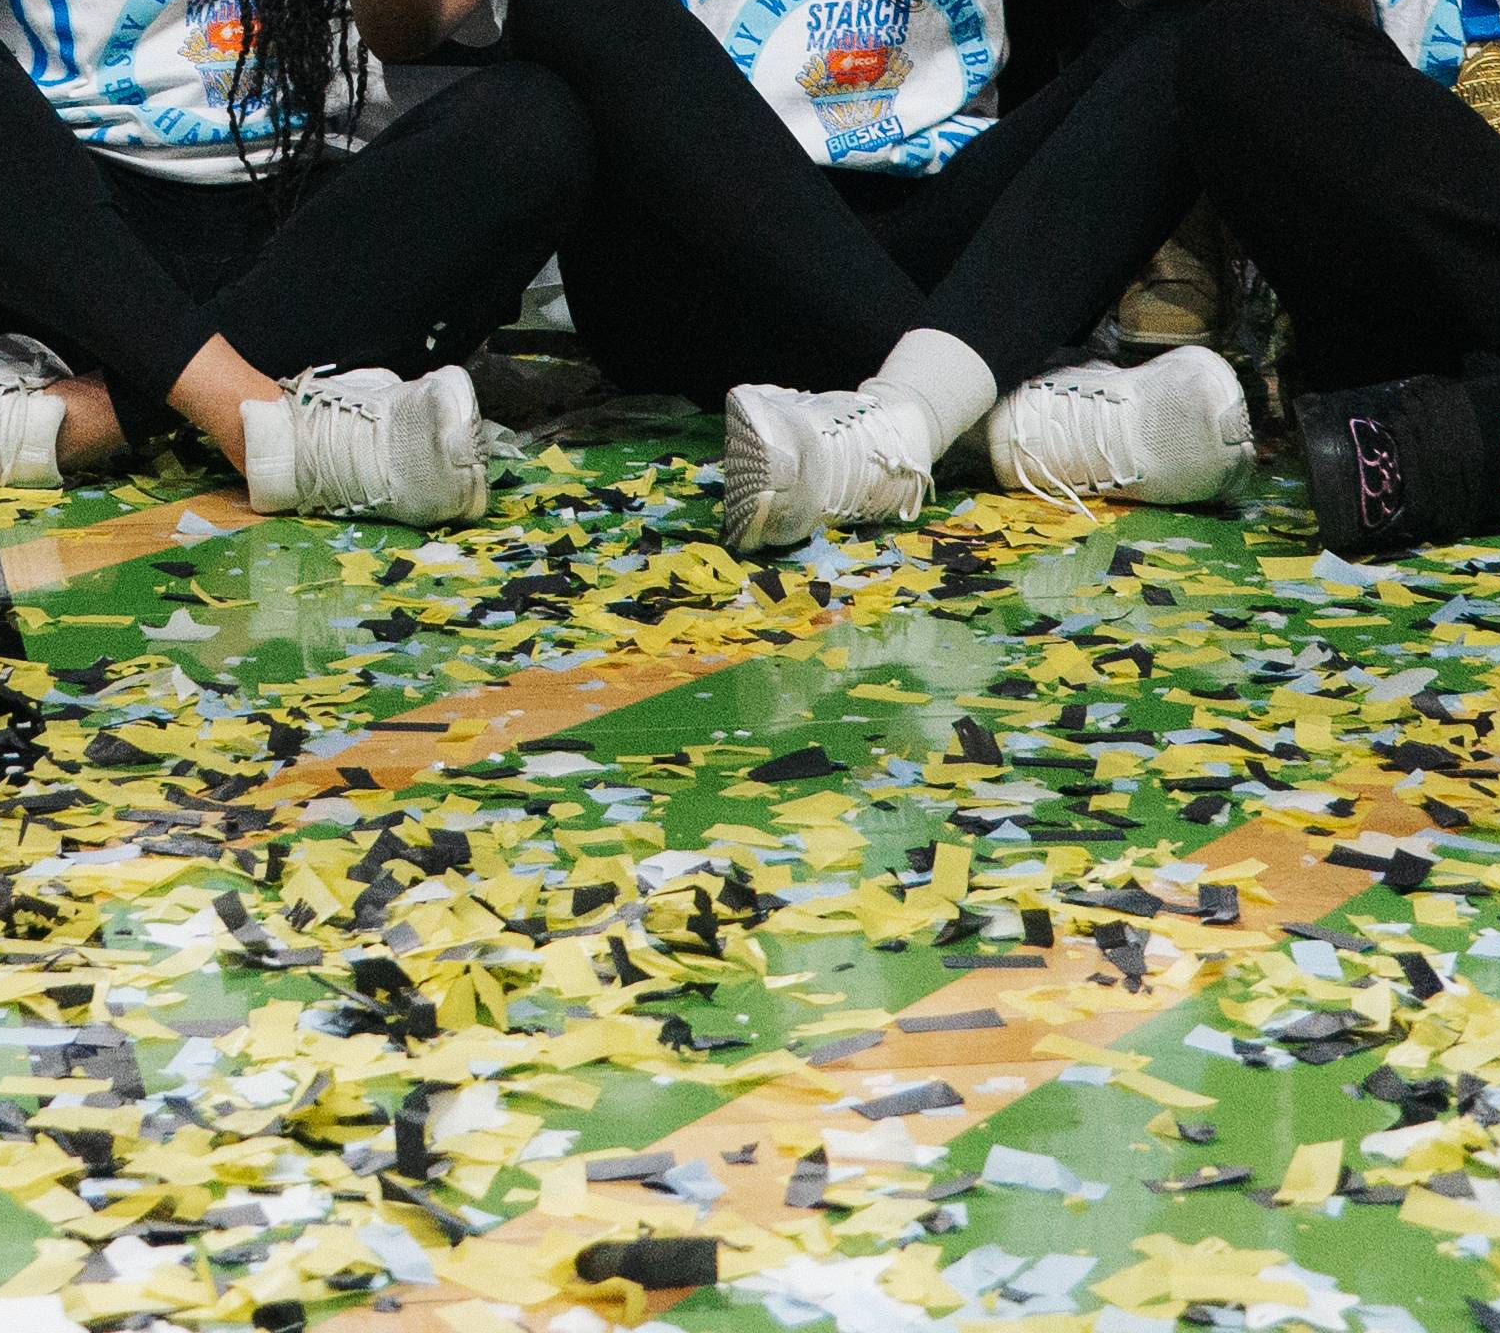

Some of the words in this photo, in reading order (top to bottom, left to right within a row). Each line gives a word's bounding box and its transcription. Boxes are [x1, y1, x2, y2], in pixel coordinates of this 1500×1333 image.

[103, 15, 146, 67] SKY
[806, 25, 910, 52] MADNESS
[826, 116, 903, 156] BIGSKY
